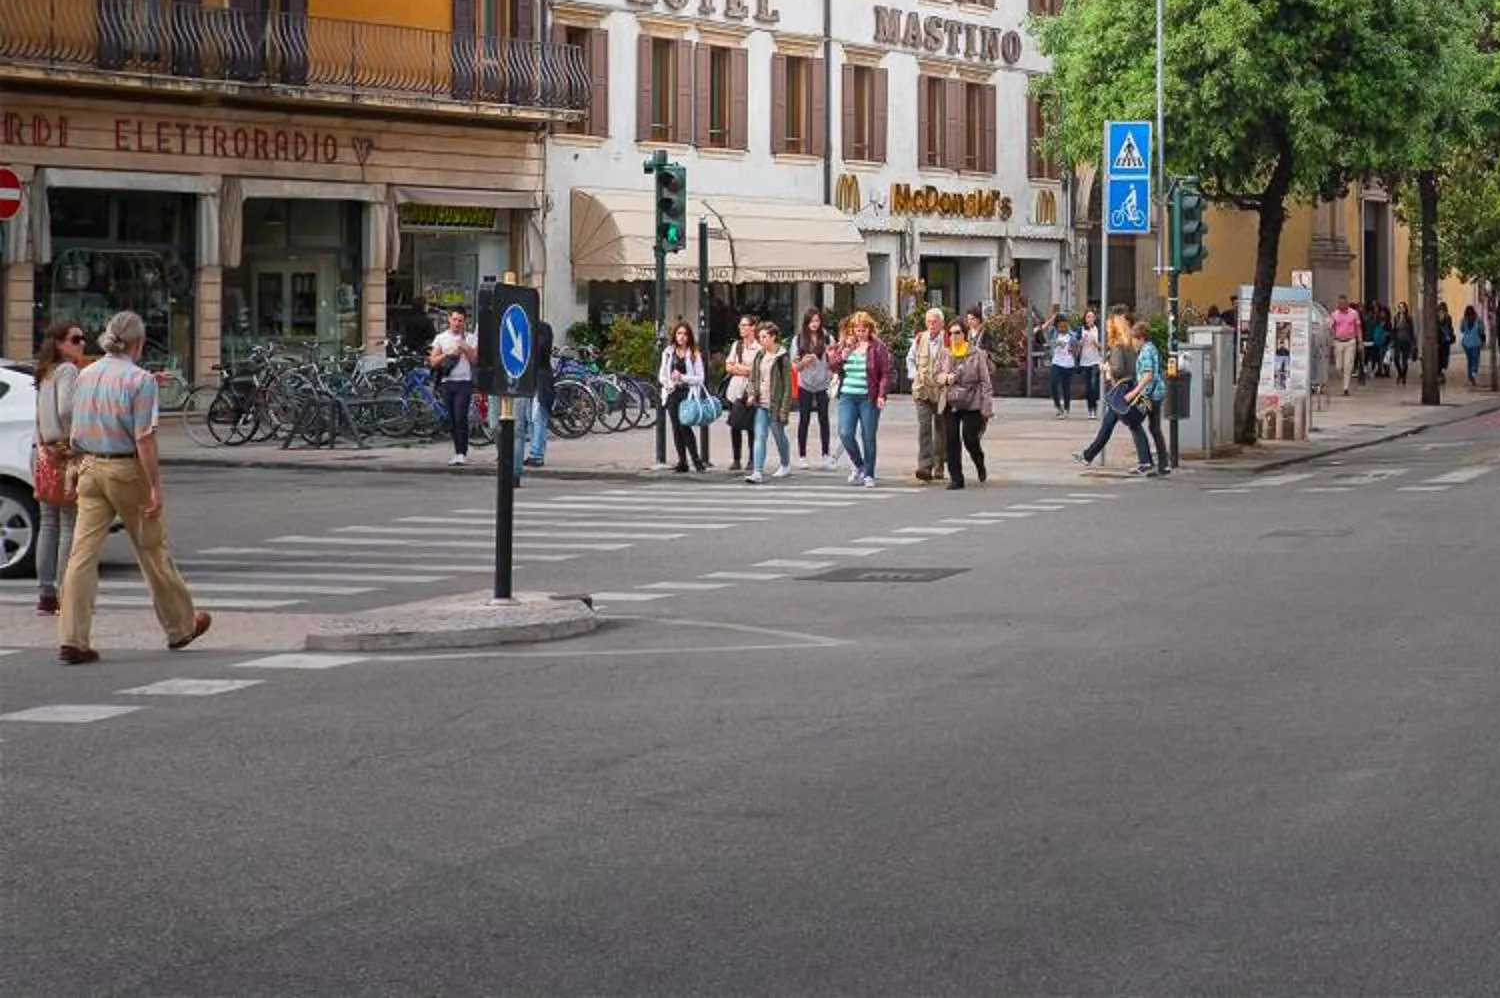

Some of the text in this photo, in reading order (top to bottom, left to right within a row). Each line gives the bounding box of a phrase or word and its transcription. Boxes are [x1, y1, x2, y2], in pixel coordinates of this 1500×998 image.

[873, 5, 1022, 65] MASTINO
[3, 111, 338, 163] RDI ELETTRORADIO
[890, 183, 1013, 221] McDonald's
